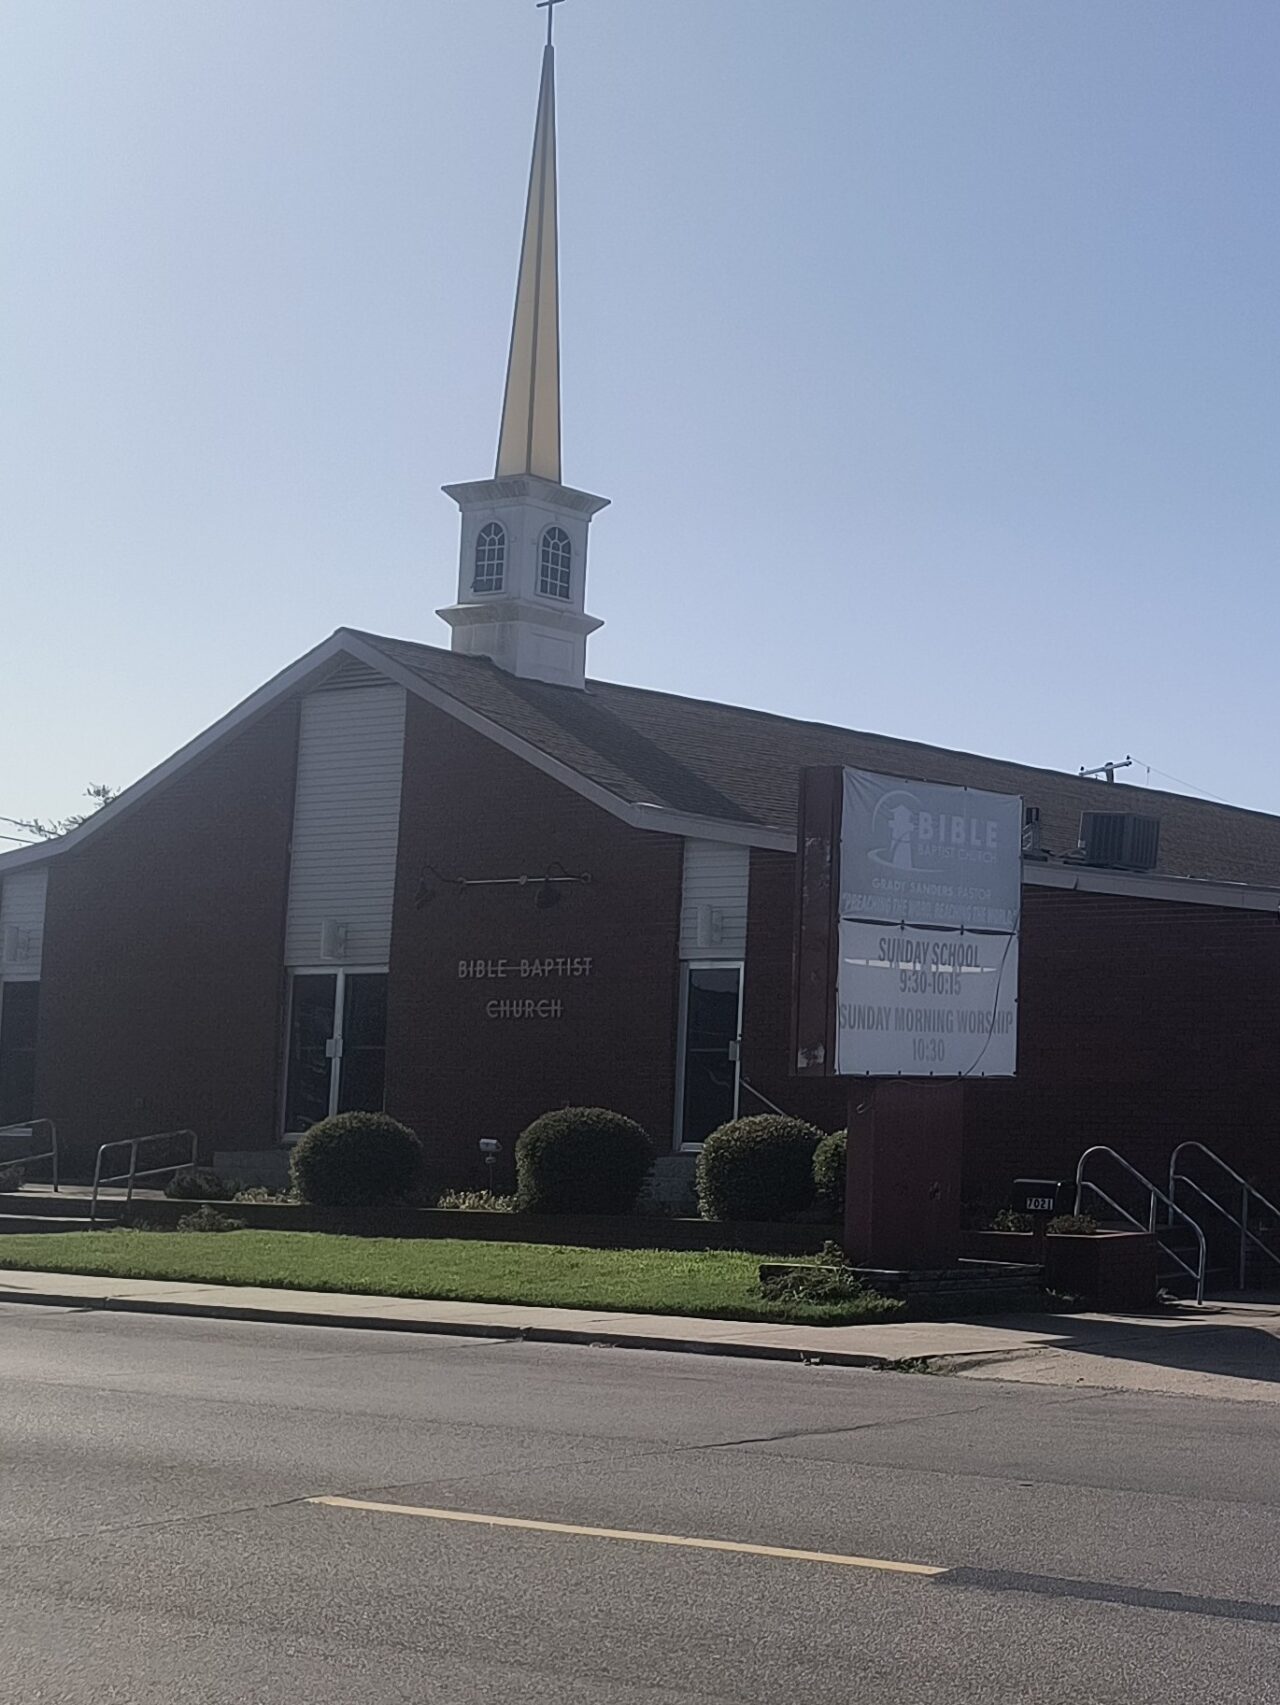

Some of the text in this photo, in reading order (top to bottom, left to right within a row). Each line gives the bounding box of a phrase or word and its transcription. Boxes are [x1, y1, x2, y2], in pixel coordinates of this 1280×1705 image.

[919, 811, 998, 847] BIBLE
[918, 842, 956, 858] BAPTIST
[872, 878, 906, 892] GRADY
[910, 881, 953, 897] SANDERS
[879, 937, 980, 968] SUNDAY SCHOOL
[458, 957, 593, 978] BIBLE BAPTIST
[899, 970, 961, 996] 9:30-10:15
[487, 999, 563, 1018] CHURCH
[840, 1004, 1014, 1034] SUNDAY MORNING WORSHIP
[913, 1038, 945, 1062] 10:30
[1028, 1199, 1051, 1209] 7021
